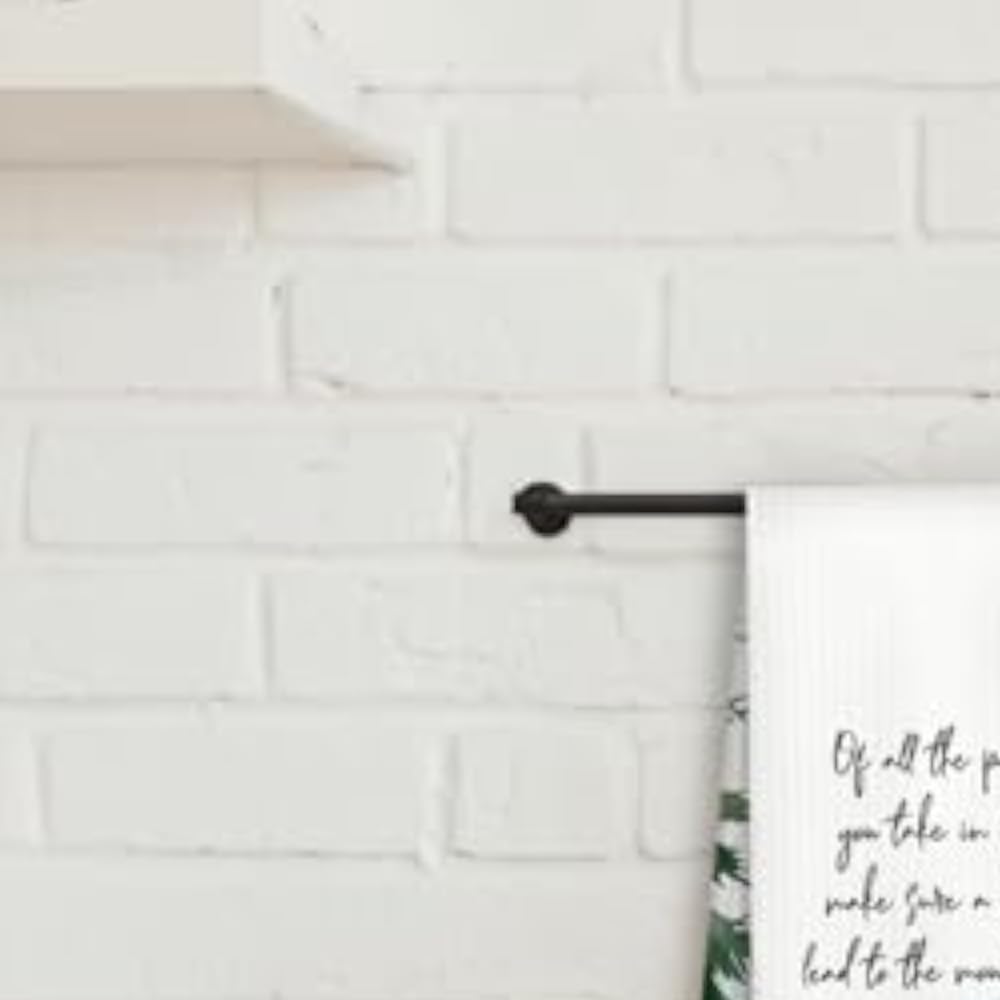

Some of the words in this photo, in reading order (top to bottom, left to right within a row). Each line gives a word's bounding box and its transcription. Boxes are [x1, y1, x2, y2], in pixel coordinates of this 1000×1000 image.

[833, 729, 870, 798] Of
[882, 732, 919, 775] all
[923, 725, 970, 777] the
[835, 826, 880, 873] you
[883, 793, 948, 848] take
[958, 820, 989, 842] in
[825, 863, 893, 918] make
[905, 882, 962, 926] sure
[972, 896, 990, 911] a
[801, 935, 862, 989] lead
[859, 941, 887, 990] to
[894, 936, 943, 990] the
